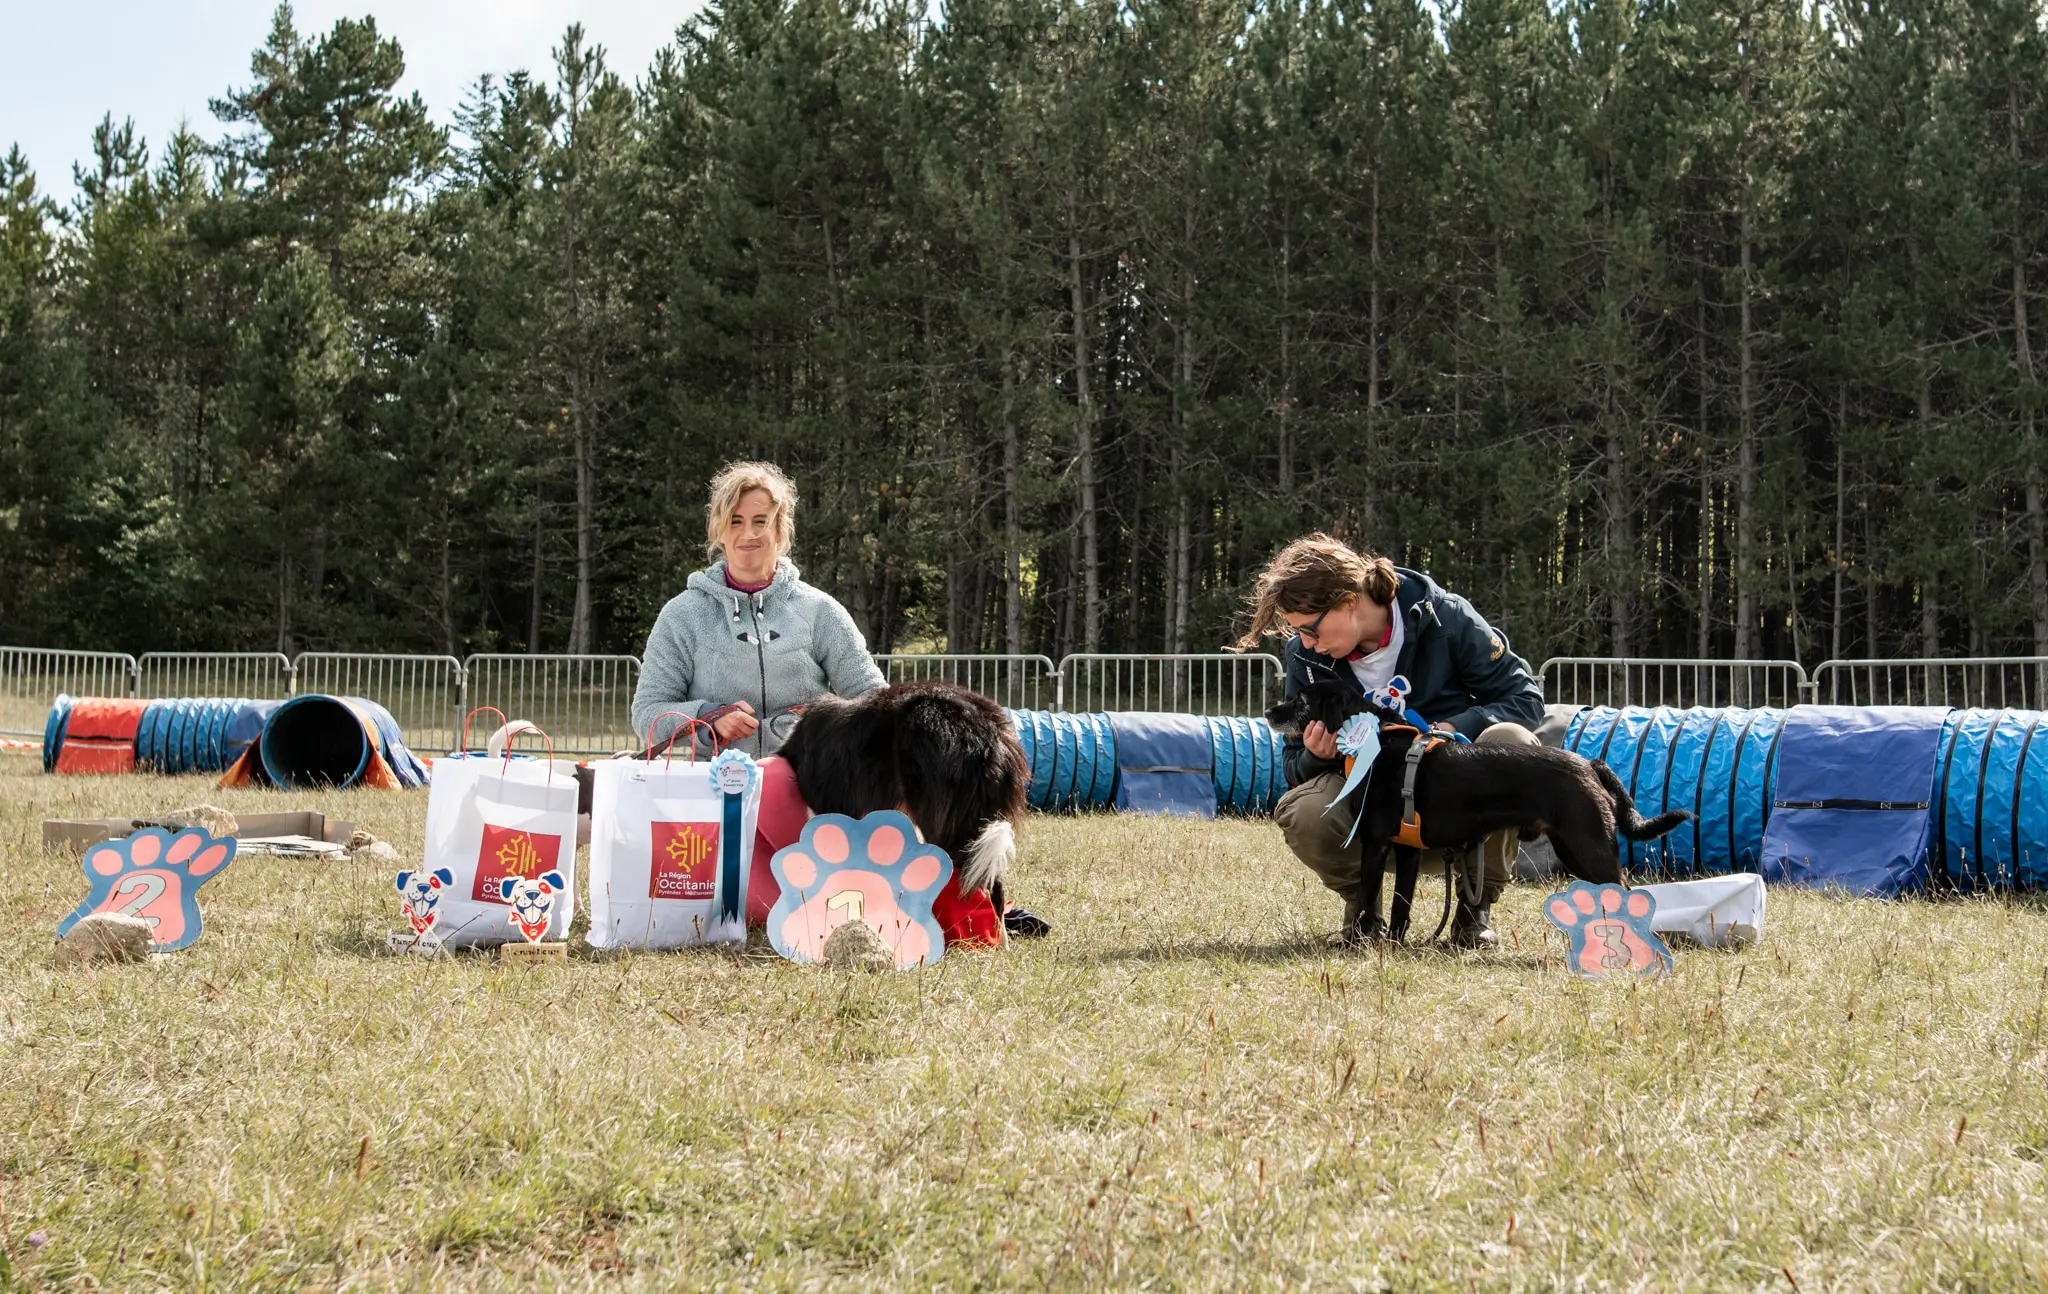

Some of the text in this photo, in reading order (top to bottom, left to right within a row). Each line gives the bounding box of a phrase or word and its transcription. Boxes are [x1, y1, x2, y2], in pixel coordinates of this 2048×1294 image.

[483, 875, 492, 883] La
[669, 872, 691, 880] Région
[659, 879, 715, 890] Occitanie
[116, 874, 166, 927] 2
[828, 890, 864, 920] 1
[422, 941, 438, 949] cup
[1594, 925, 1631, 969] 3
